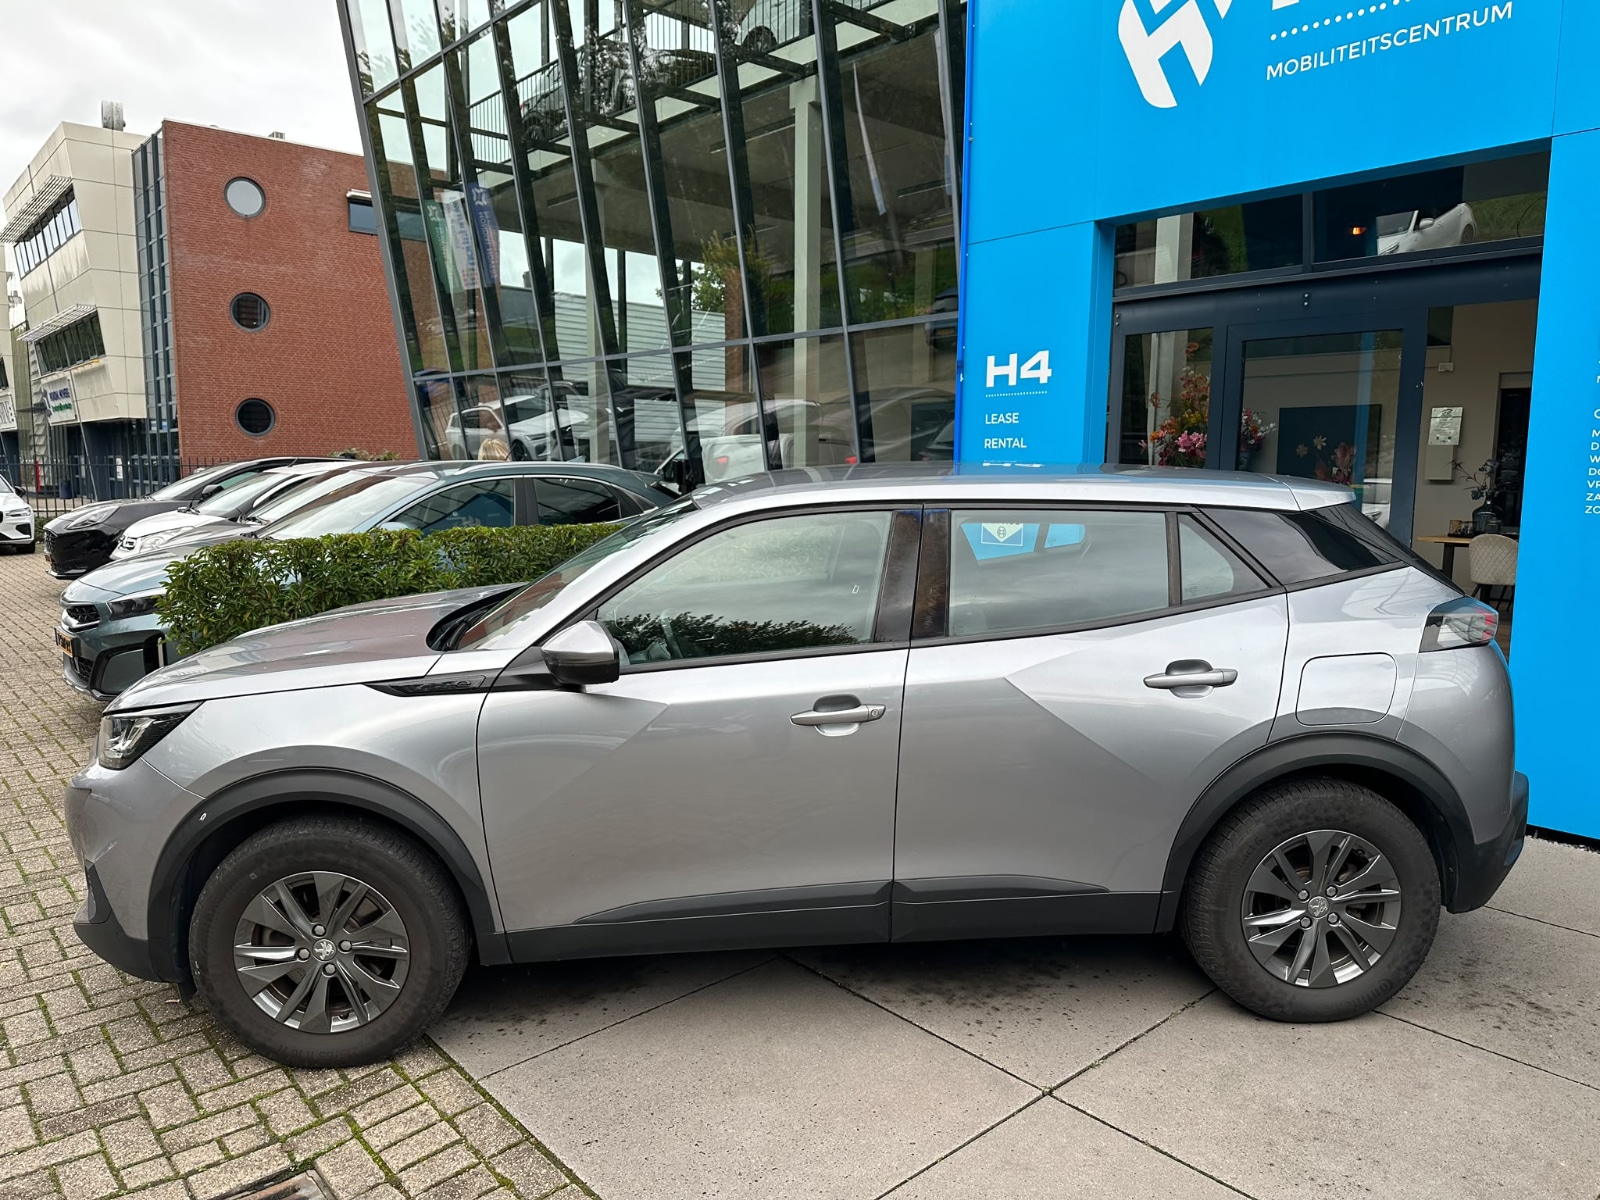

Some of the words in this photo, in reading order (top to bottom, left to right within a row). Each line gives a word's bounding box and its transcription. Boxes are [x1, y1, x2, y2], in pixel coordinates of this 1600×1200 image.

[1266, 1, 1513, 81] MOBILITEITSCENTRUM
[986, 350, 1052, 388] H4
[985, 412, 1020, 425] LEASE
[984, 437, 1028, 449] RENTAL
